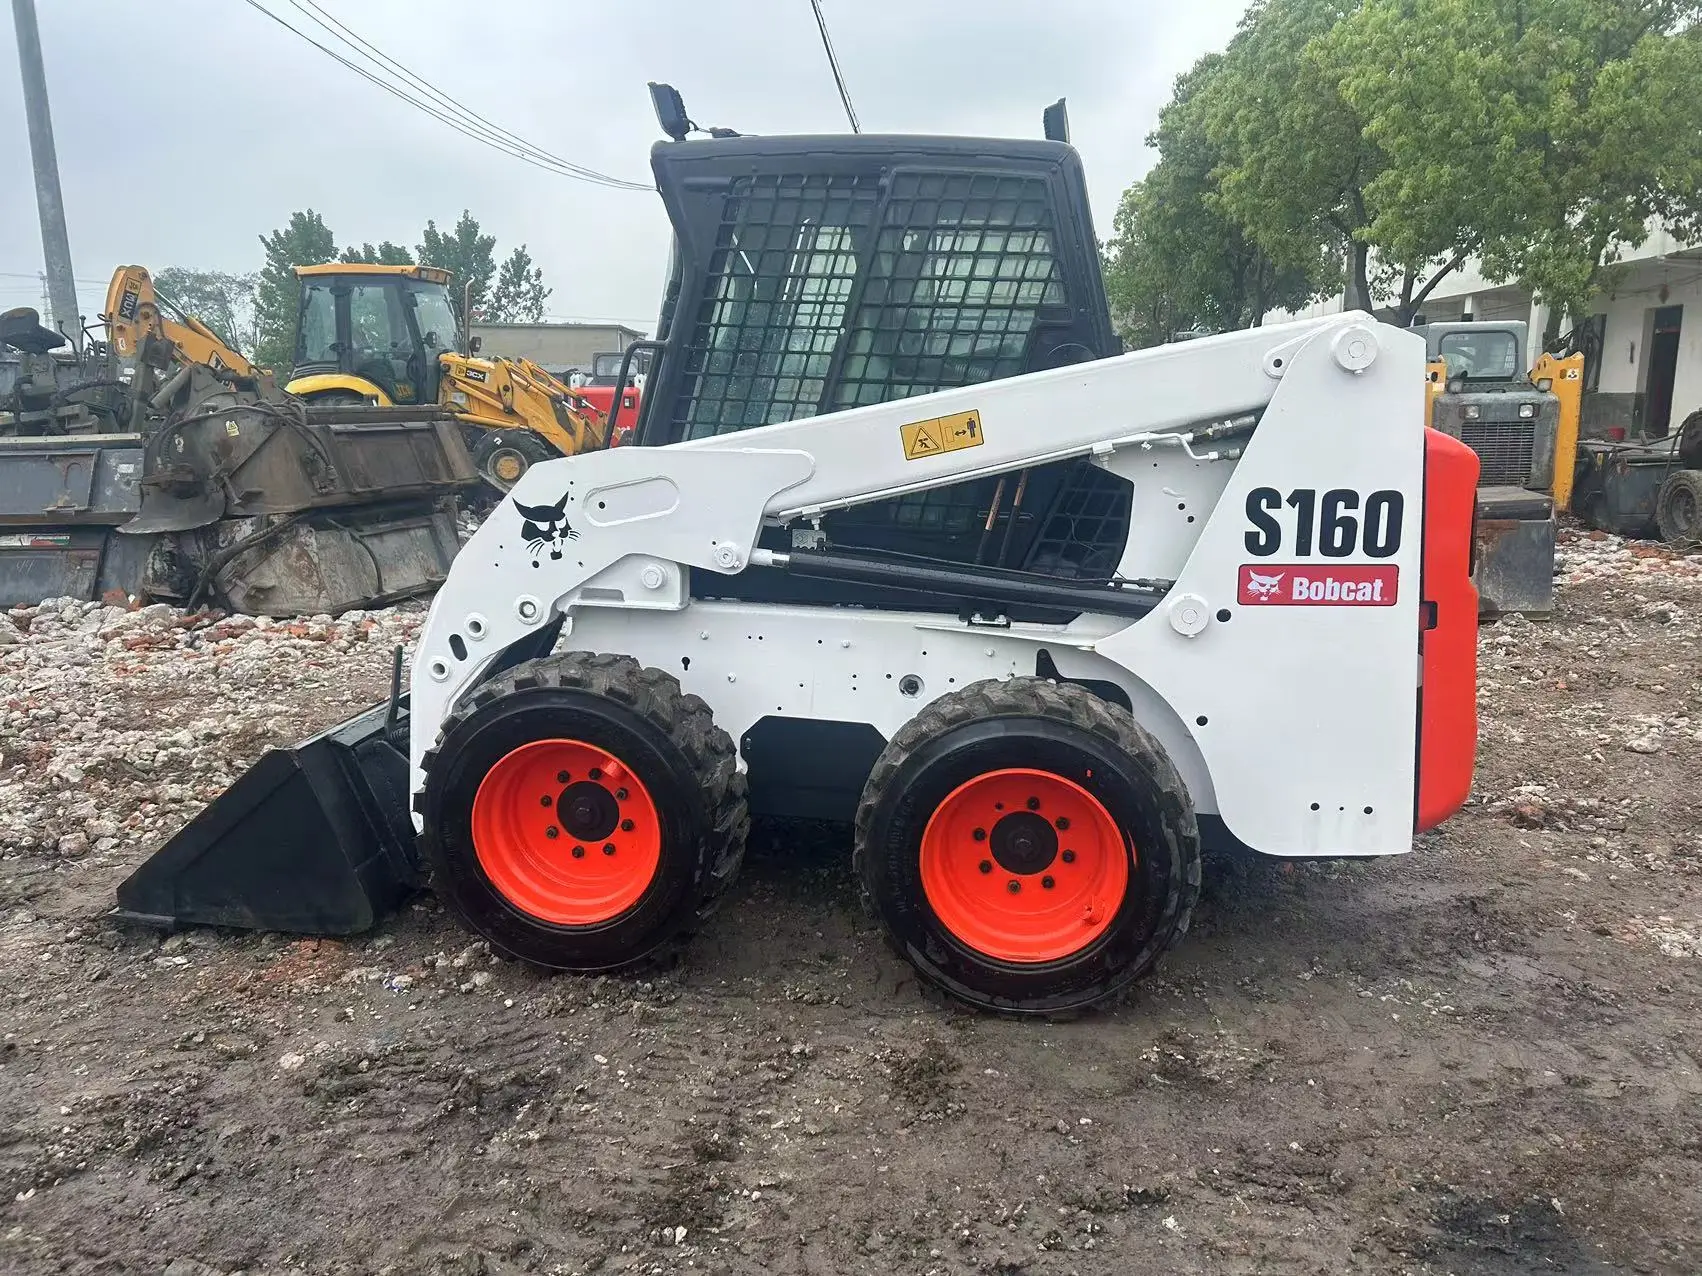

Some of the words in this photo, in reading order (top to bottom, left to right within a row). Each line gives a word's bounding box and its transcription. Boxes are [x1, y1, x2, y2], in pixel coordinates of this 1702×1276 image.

[466, 370, 485, 380] 3CX
[1244, 486, 1404, 558] S160
[1292, 576, 1384, 602] Bobcat
